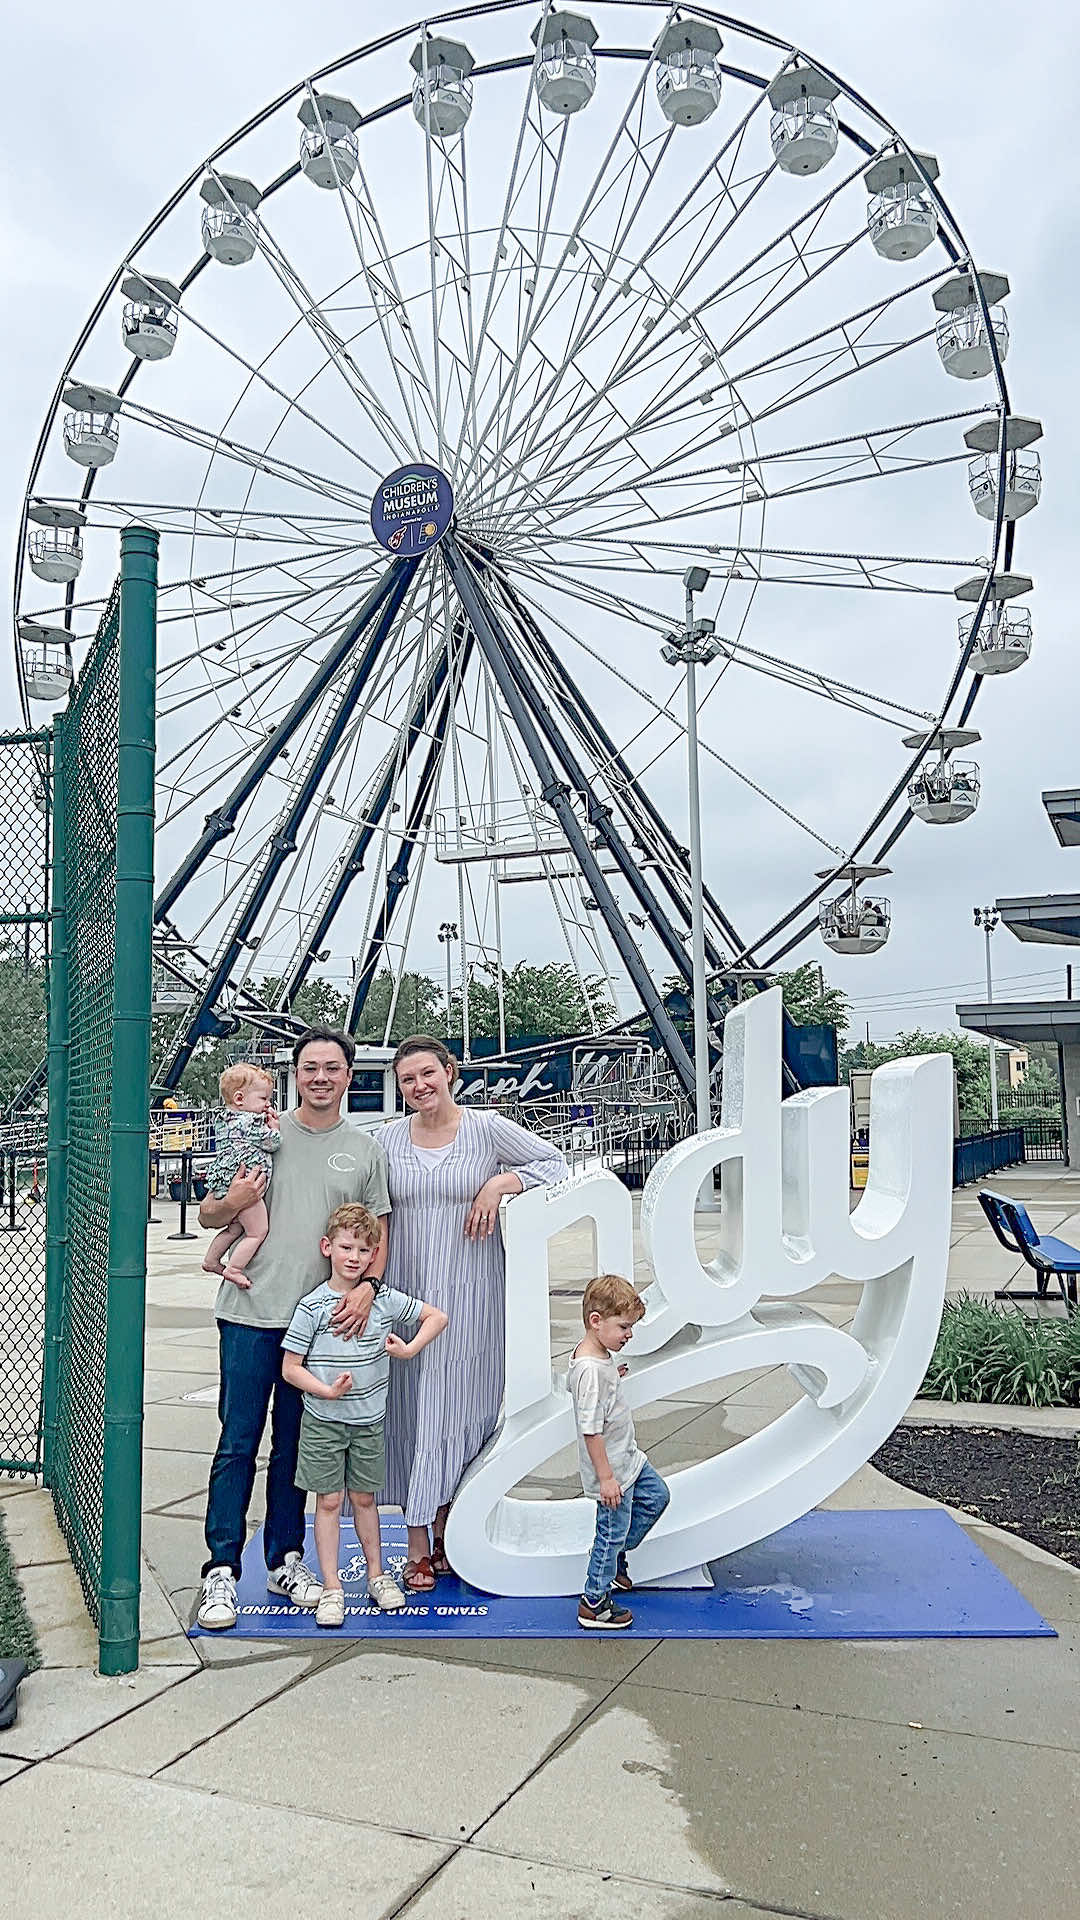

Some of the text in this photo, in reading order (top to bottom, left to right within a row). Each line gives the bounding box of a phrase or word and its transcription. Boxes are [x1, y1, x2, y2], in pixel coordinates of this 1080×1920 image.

[382, 478, 438, 499] CHILDREN'S
[383, 491, 439, 513] MUSEUM
[383, 504, 438, 521] INDIANAPOLIS
[327, 1152, 356, 1172] C
[434, 1605, 489, 1616] STAND.
